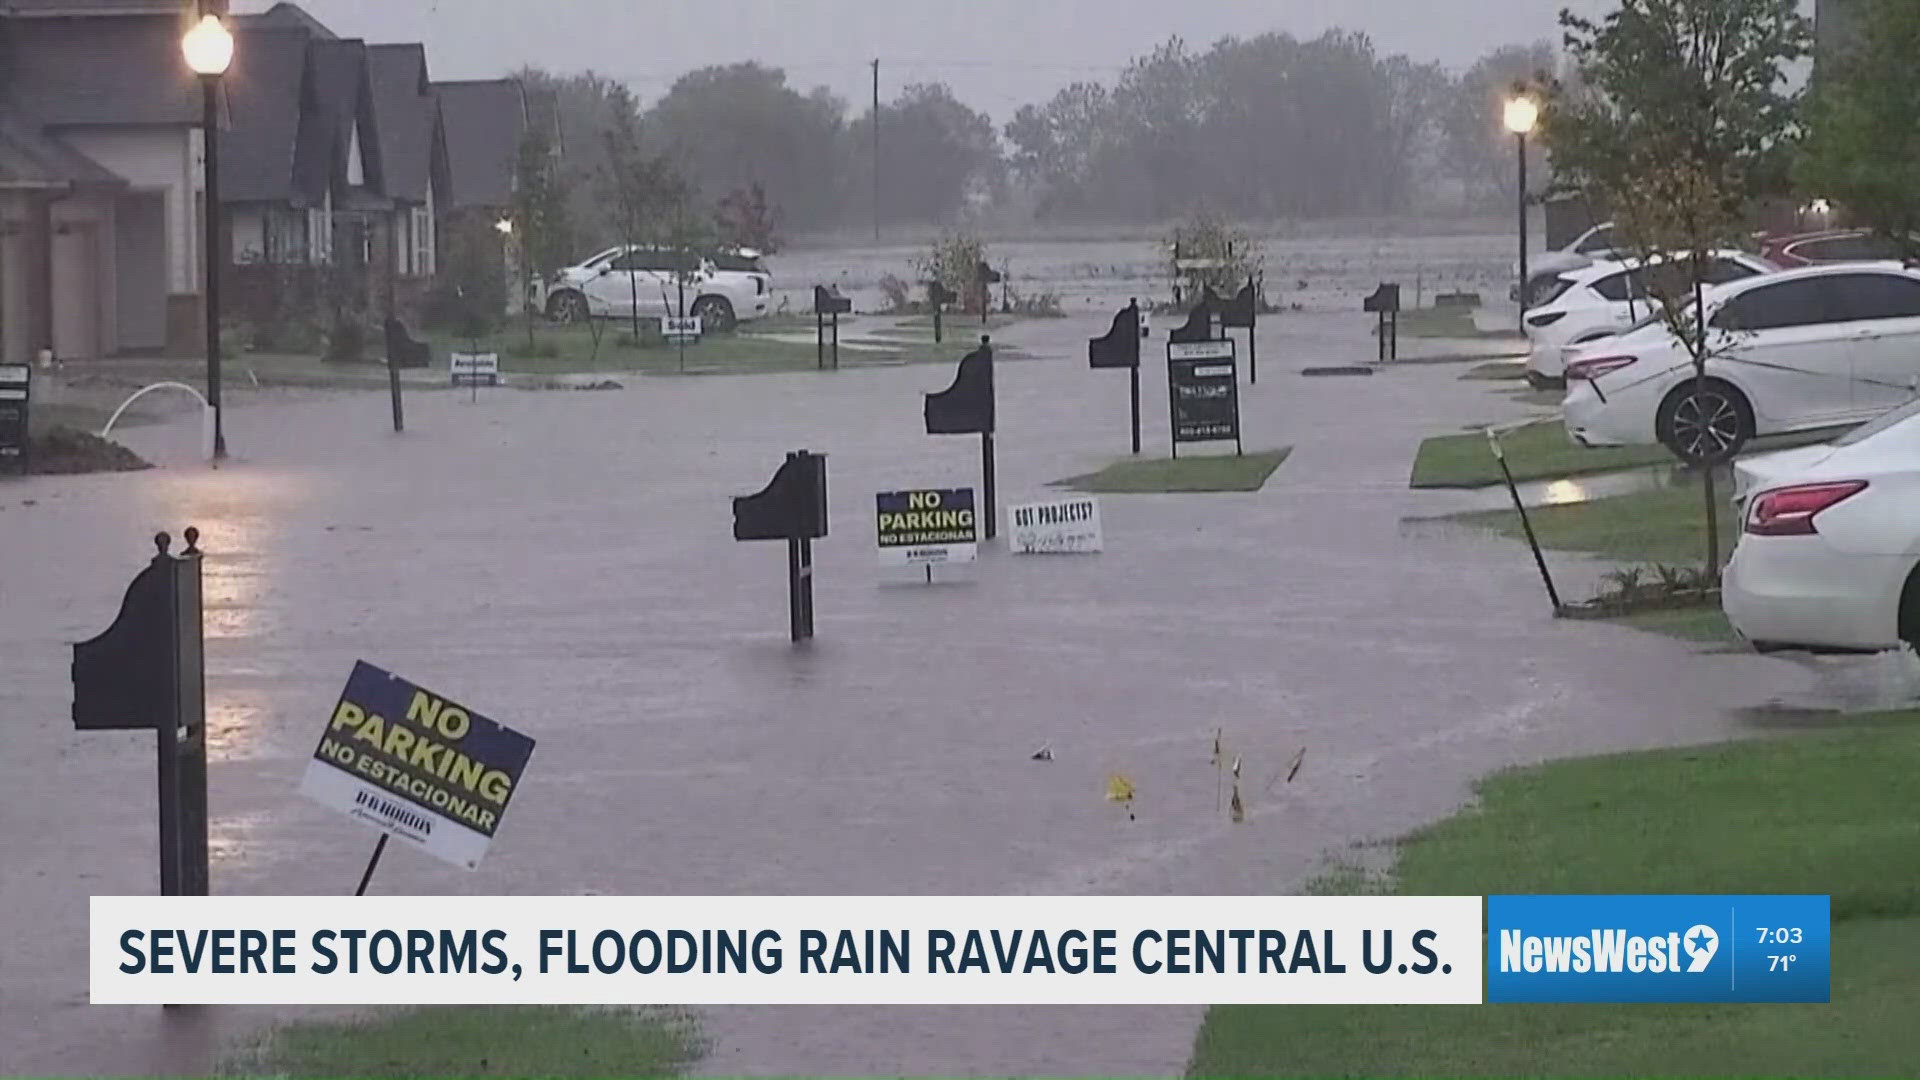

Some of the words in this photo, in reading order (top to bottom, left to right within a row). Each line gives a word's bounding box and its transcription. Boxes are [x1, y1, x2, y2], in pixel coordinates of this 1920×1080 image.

[909, 492, 941, 509] NO
[879, 509, 973, 531] PARKING
[1015, 506, 1035, 527] GOT
[1038, 501, 1093, 525] PROJECTS?
[880, 534, 898, 544] NO
[899, 530, 973, 543] ESTACIONAR
[406, 690, 470, 740] NO
[331, 700, 512, 805] PARKING
[321, 737, 355, 764] NO
[356, 757, 496, 831] ESTACIONAR
